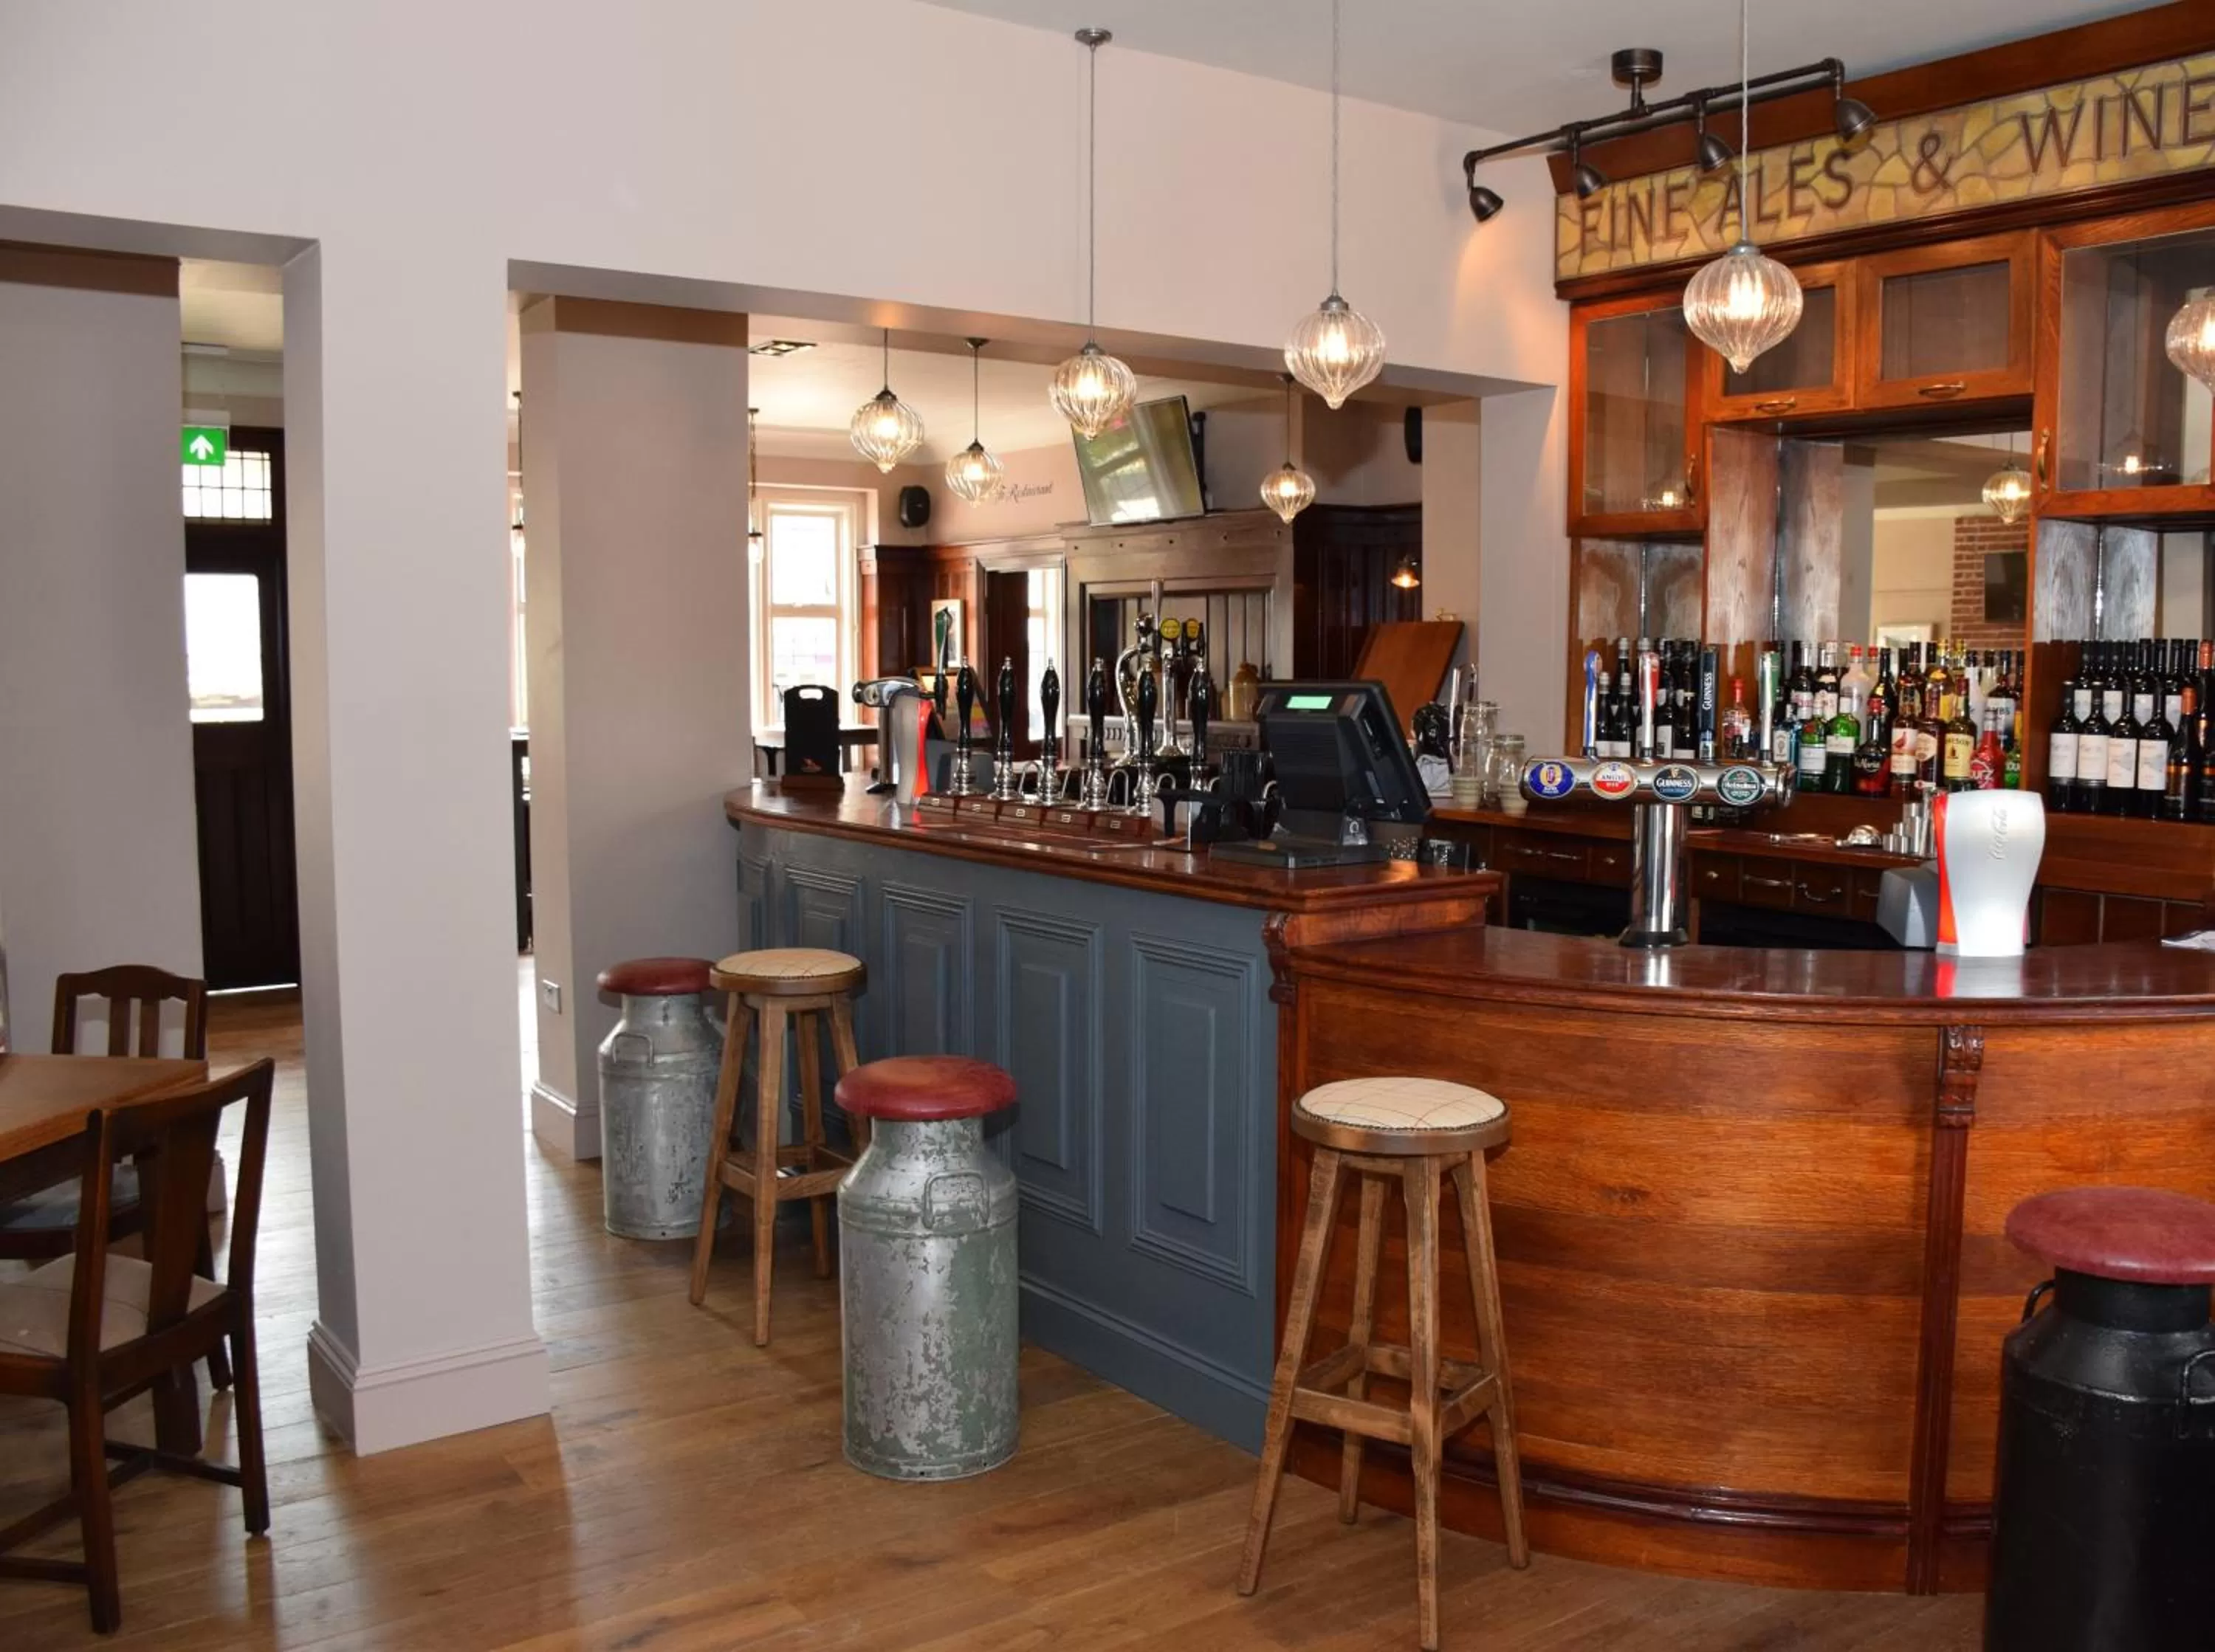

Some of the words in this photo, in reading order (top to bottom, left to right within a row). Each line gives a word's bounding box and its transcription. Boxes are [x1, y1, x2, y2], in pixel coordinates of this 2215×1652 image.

[1579, 181, 1690, 256] FINE
[1713, 149, 1852, 234] ALES
[1912, 132, 1955, 193] &
[2020, 76, 2215, 173] WINE
[1702, 672, 1713, 710] GUINNESS
[1656, 778, 1692, 788] GUINNESS
